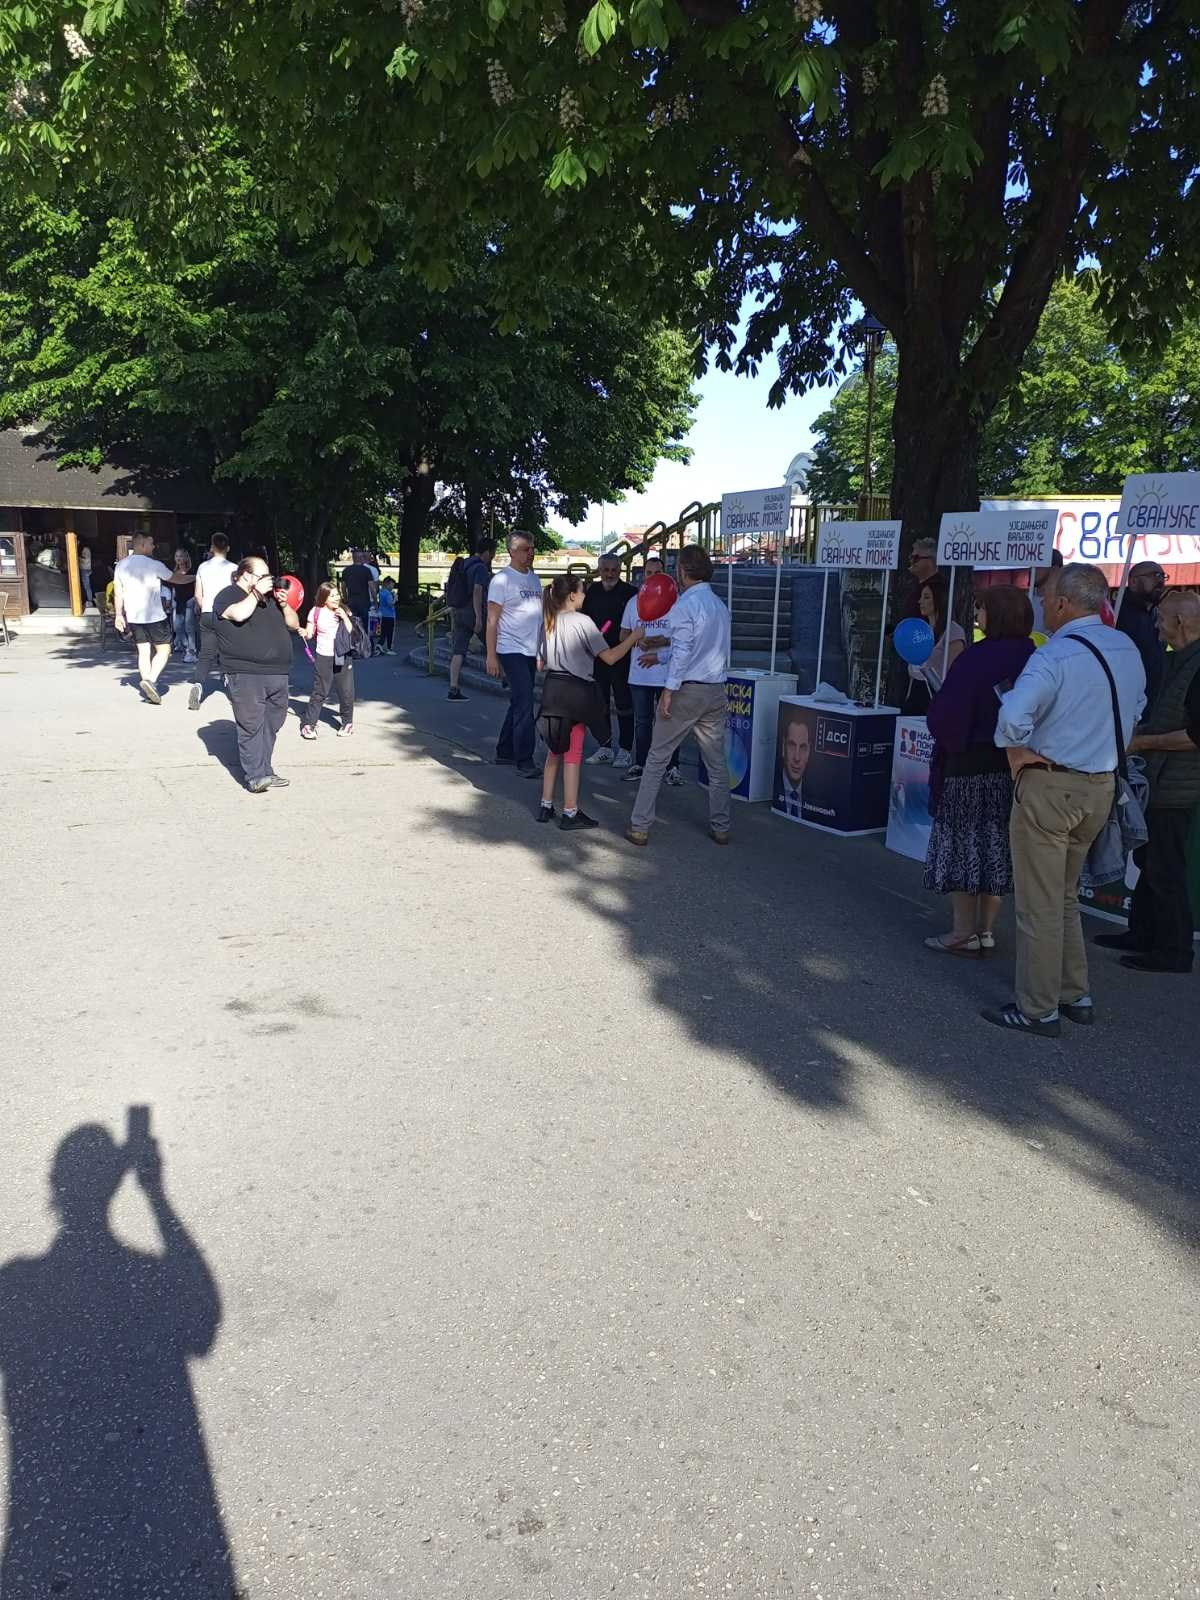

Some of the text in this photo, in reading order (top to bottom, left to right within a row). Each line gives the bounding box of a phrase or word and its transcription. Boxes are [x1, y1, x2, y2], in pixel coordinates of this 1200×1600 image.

[762, 511, 784, 527] МОЖЕ
[1127, 504, 1200, 529] СВАНУЋЕ
[822, 547, 893, 566] СВАНУЋЕ МОЖЕ
[944, 542, 1045, 561] СВАНУЋЕ МОЖЕ
